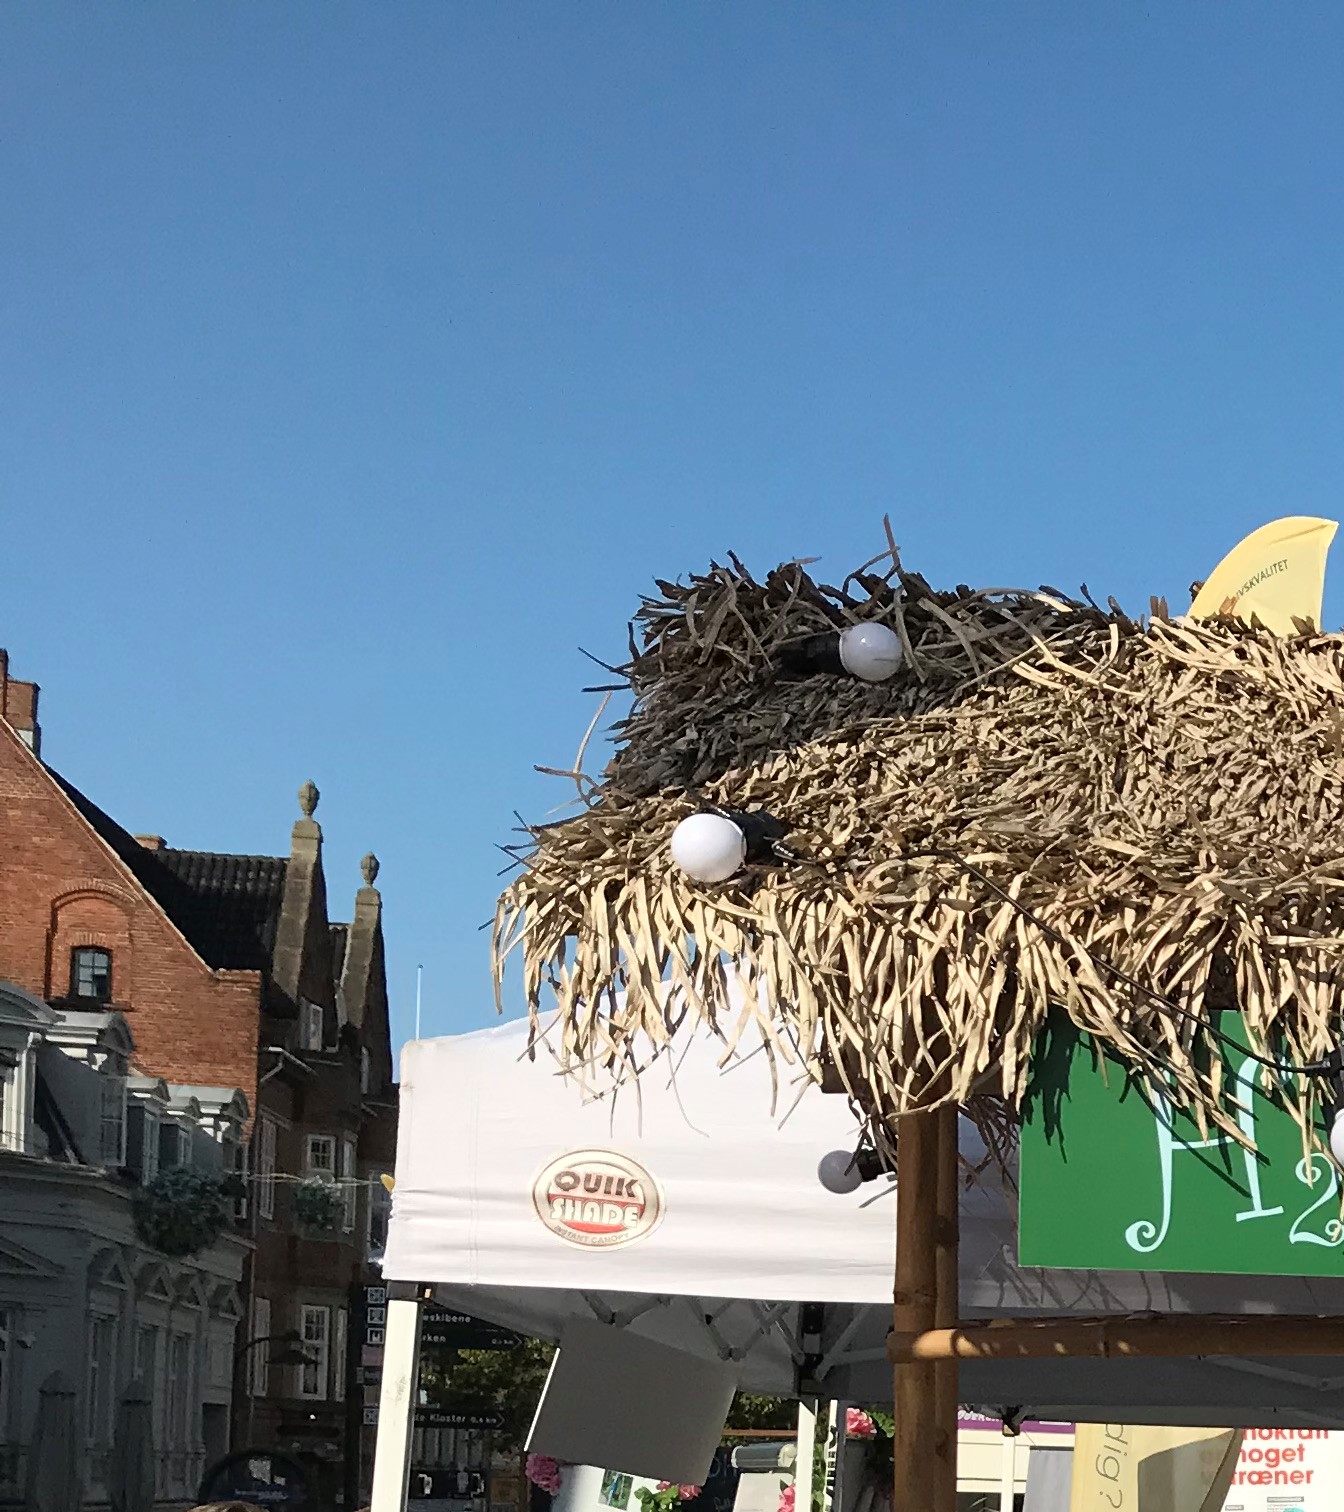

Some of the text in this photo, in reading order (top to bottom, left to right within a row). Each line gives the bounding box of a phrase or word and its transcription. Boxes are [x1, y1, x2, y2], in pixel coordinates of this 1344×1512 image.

[1237, 559, 1288, 597] VSKVALITET
[554, 1171, 639, 1197] QUIK
[551, 1198, 640, 1228] SHADE
[554, 1225, 629, 1243] INSTANT CANOPY
[423, 1314, 471, 1323] eskibene
[430, 1414, 466, 1423] Kloster
